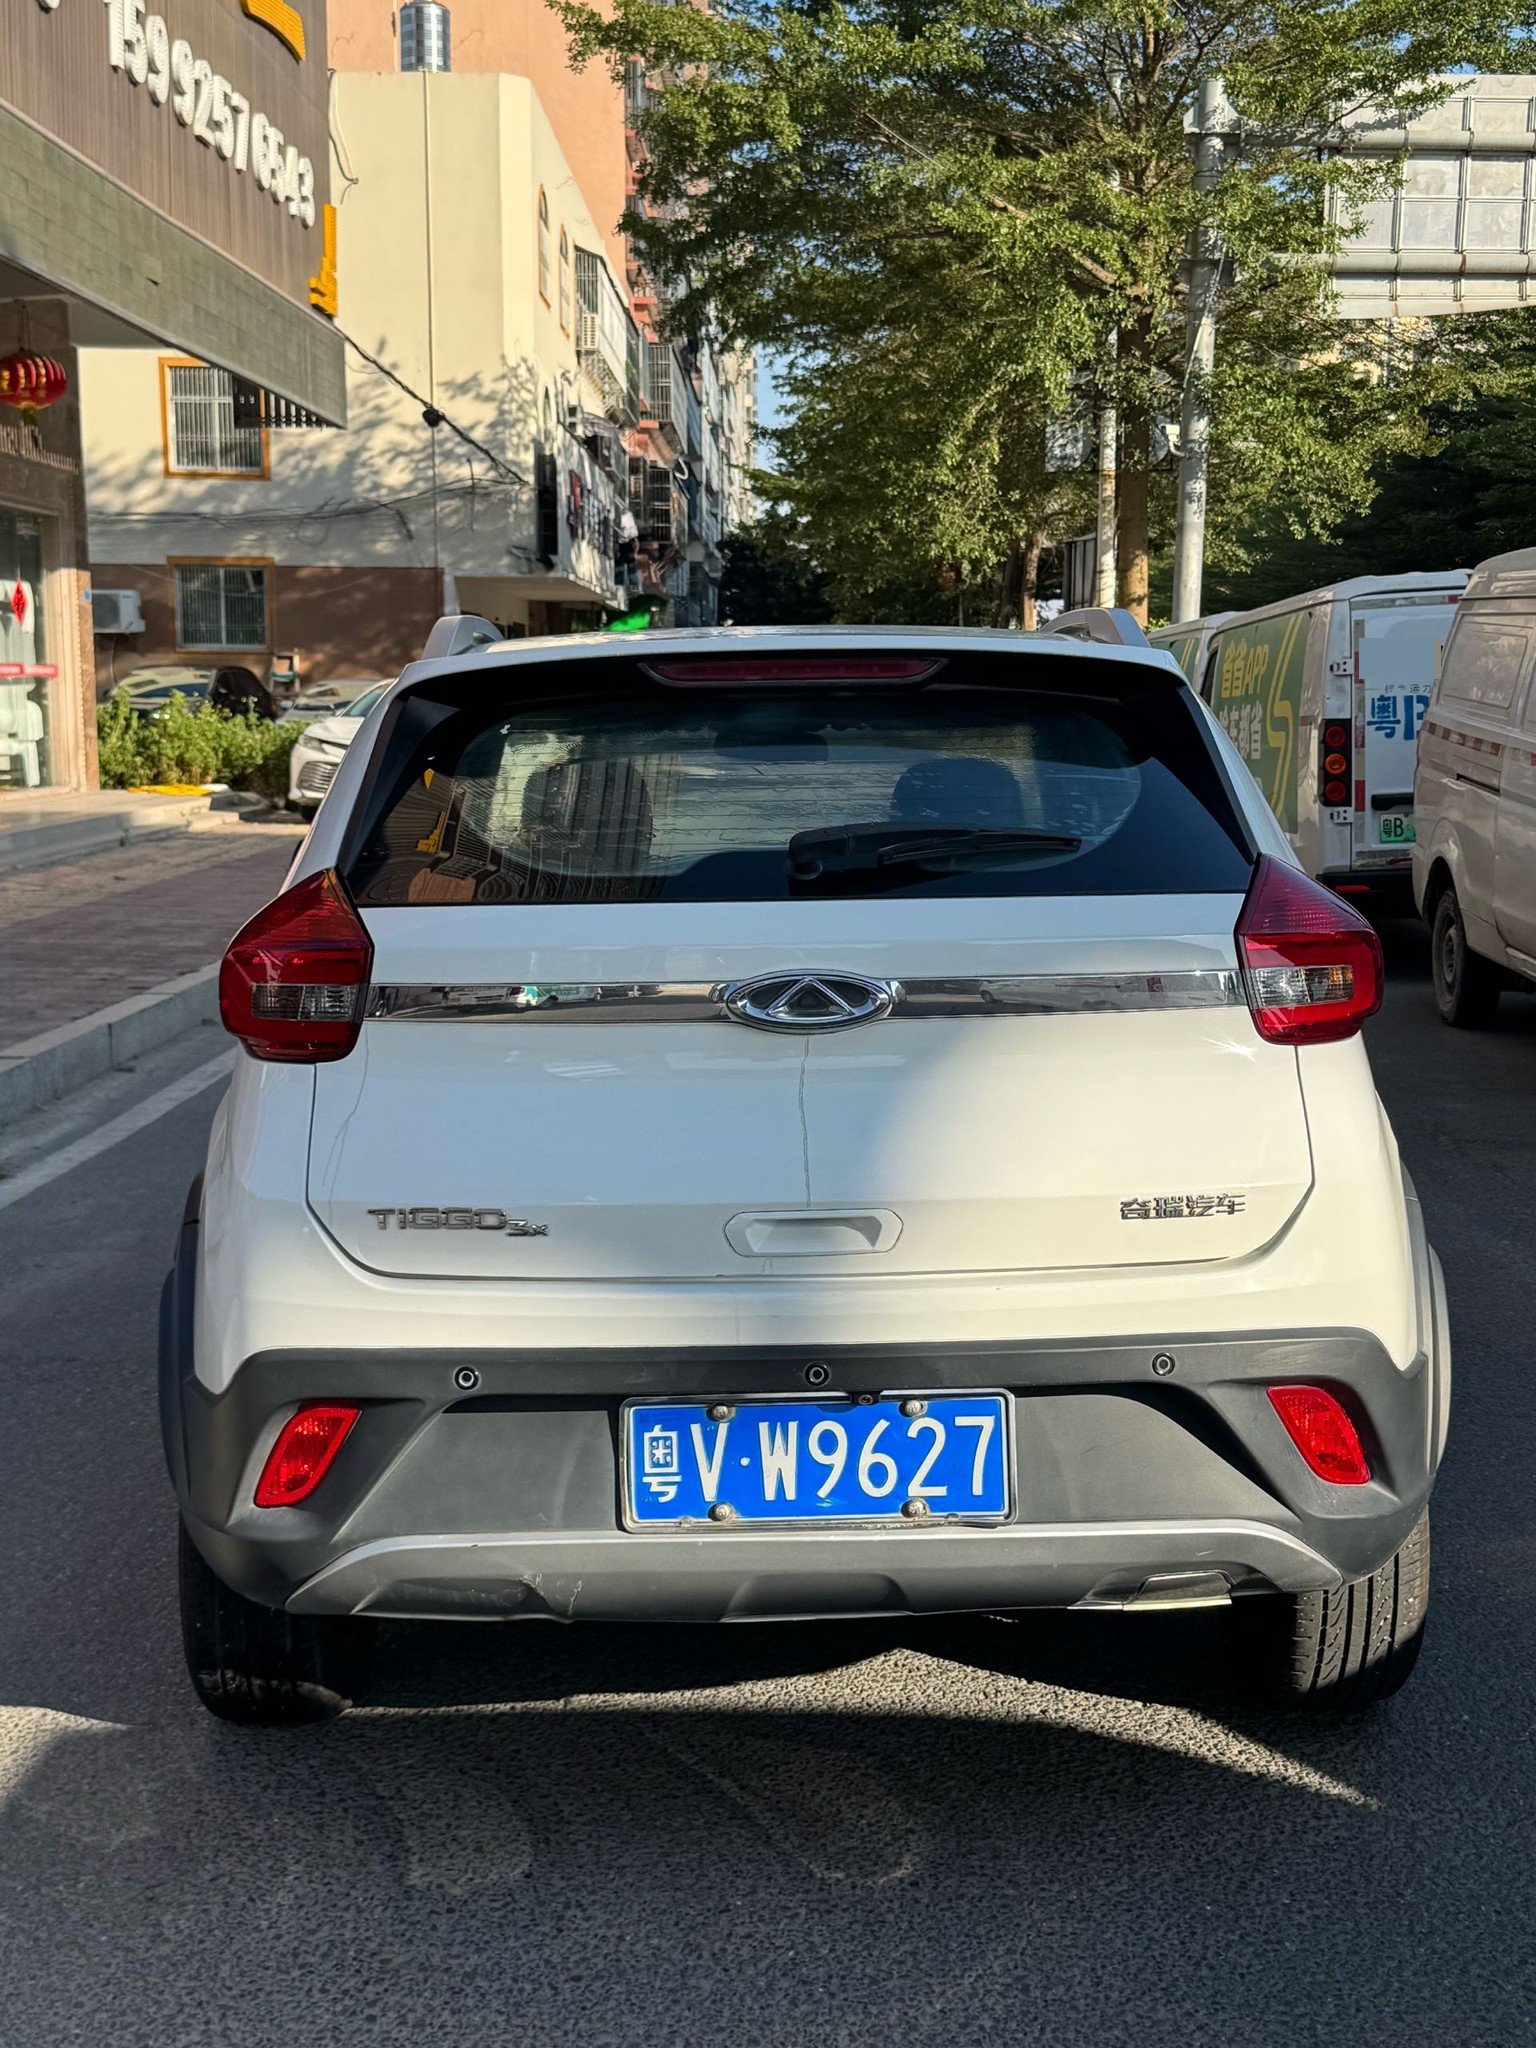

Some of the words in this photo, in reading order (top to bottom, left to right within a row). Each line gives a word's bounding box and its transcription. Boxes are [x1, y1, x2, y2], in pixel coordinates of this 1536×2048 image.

[367, 1207, 507, 1230] TIGGO
[1120, 1193, 1246, 1220] 奇瑞汽车
[641, 1415, 996, 1503] 粤V·W9627
